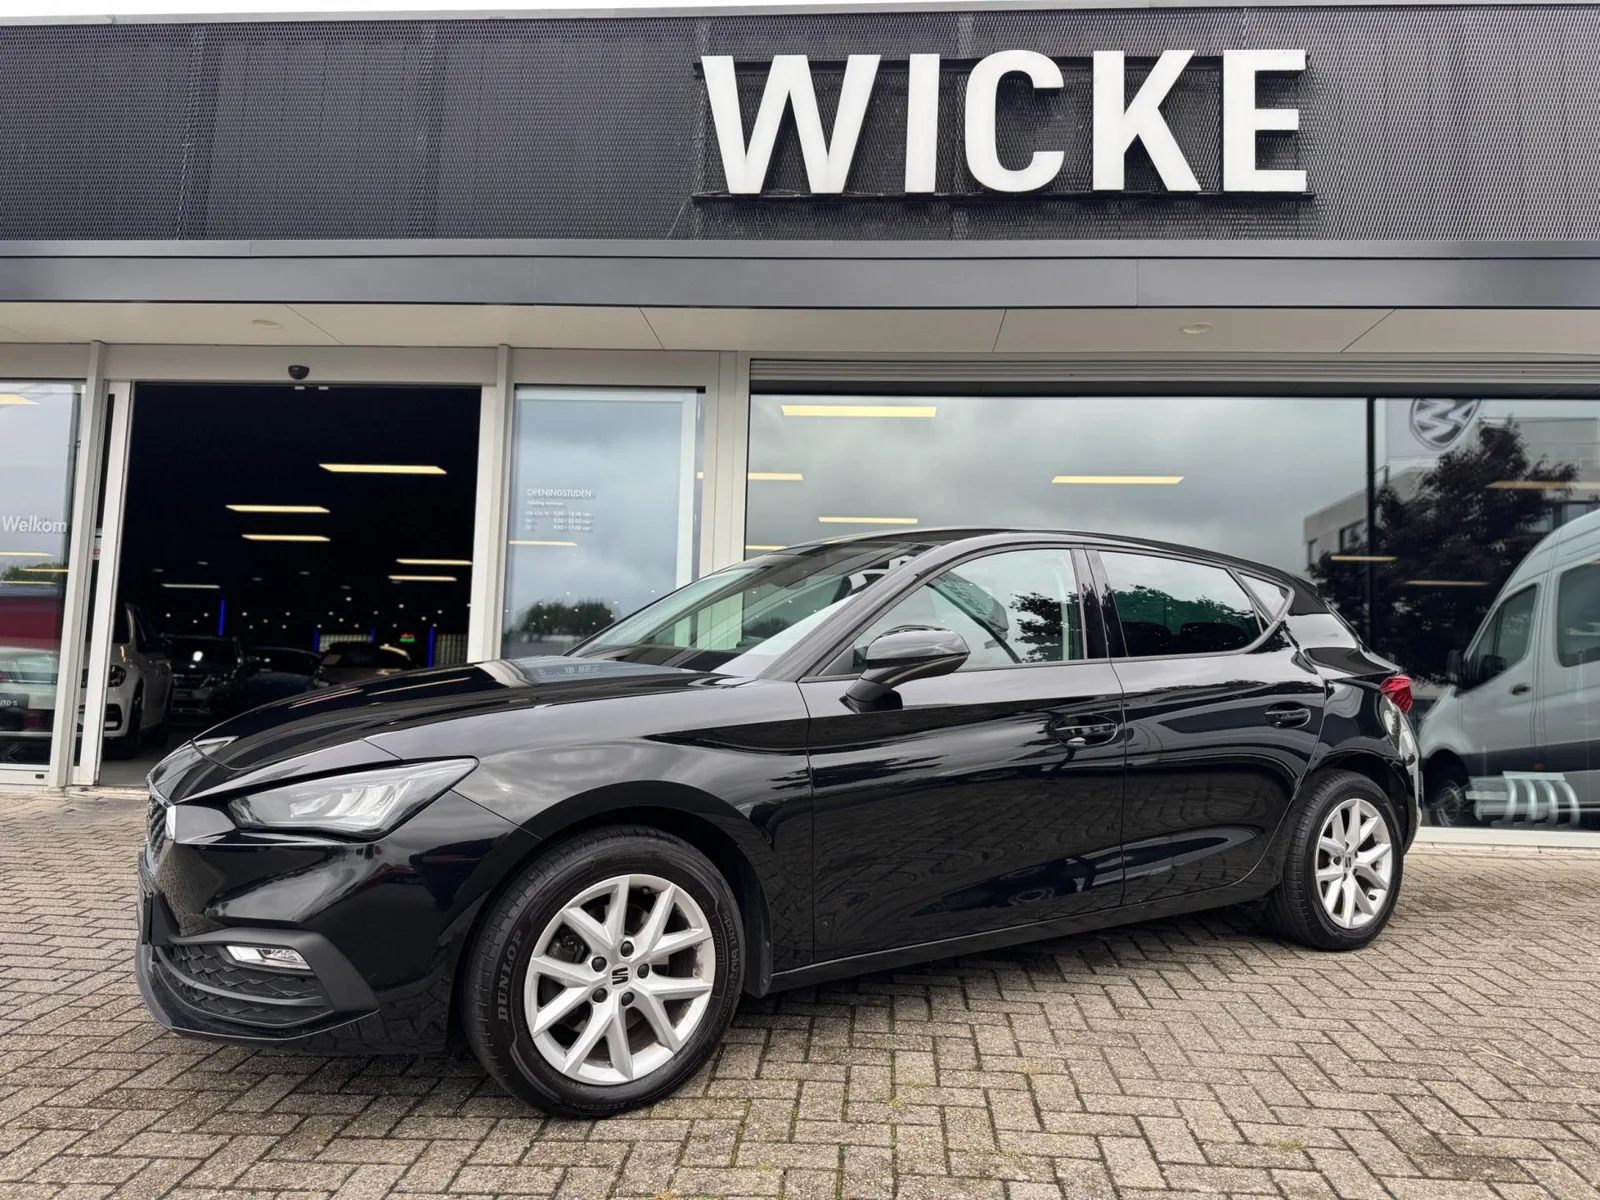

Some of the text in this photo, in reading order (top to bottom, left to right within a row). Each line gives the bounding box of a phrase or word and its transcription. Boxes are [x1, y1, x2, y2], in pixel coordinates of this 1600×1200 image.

[701, 49, 1307, 194] WICKE
[2, 515, 67, 532] Welkom
[497, 929, 521, 1022] DUNLOP
